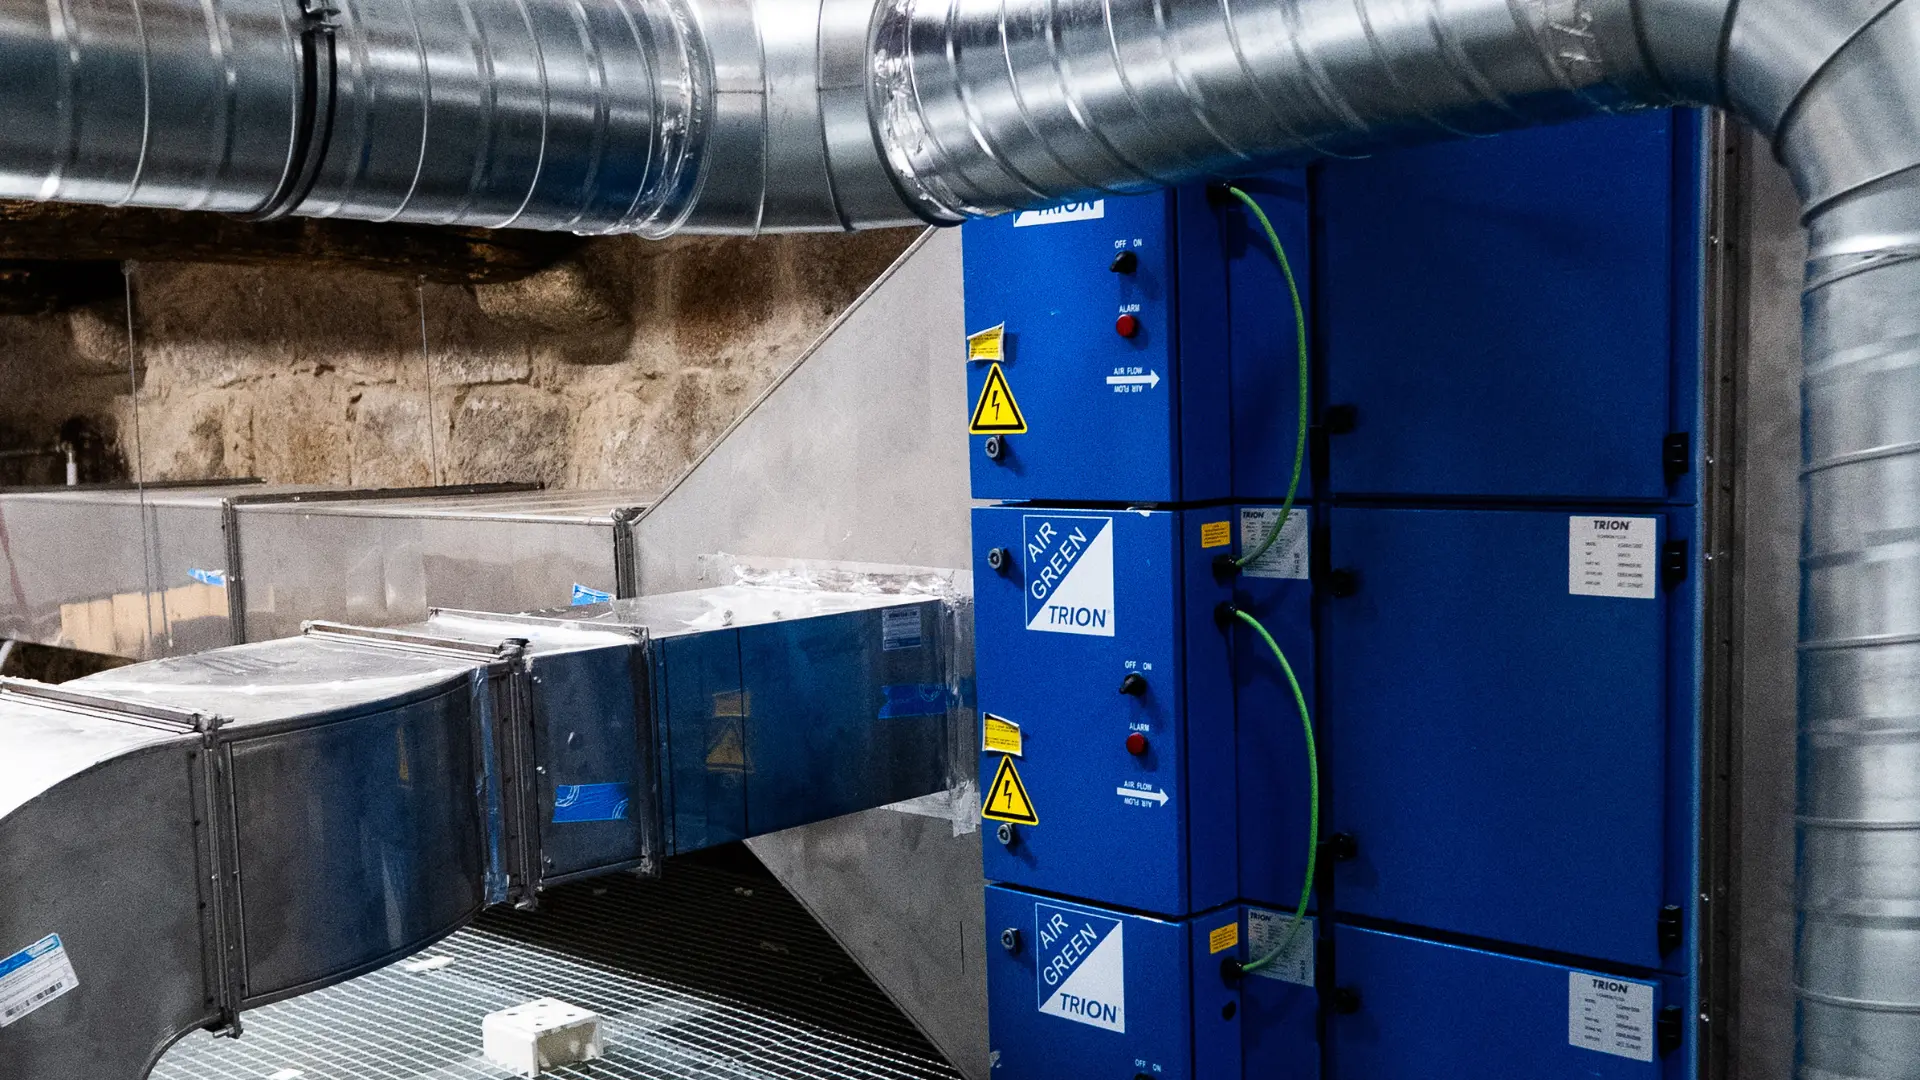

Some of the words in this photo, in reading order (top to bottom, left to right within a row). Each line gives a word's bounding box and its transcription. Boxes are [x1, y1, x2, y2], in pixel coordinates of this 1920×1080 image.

[1114, 239, 1127, 249] OFF
[1133, 238, 1143, 247] ON
[1119, 304, 1140, 313] ALARM
[1113, 367, 1125, 375] AIR
[1127, 366, 1143, 375] FLOW
[1242, 511, 1265, 519] TRION
[1593, 520, 1630, 531] TRION
[1027, 521, 1058, 563] AIR
[1031, 526, 1087, 600] GREEN
[1048, 605, 1107, 628] TRION
[1124, 660, 1137, 669] OFF
[1142, 662, 1152, 671] ON
[1129, 722, 1150, 732] ALARM
[1123, 780, 1135, 789] AIR
[1136, 781, 1152, 791] FLOW
[1250, 911, 1272, 921] TRION
[1040, 912, 1069, 950] AIR
[1043, 922, 1098, 986] GREEN
[1592, 978, 1629, 994] TRION
[1060, 992, 1117, 1024] TRION
[1134, 1058, 1146, 1068] OFF
[1152, 1063, 1162, 1073] ON
